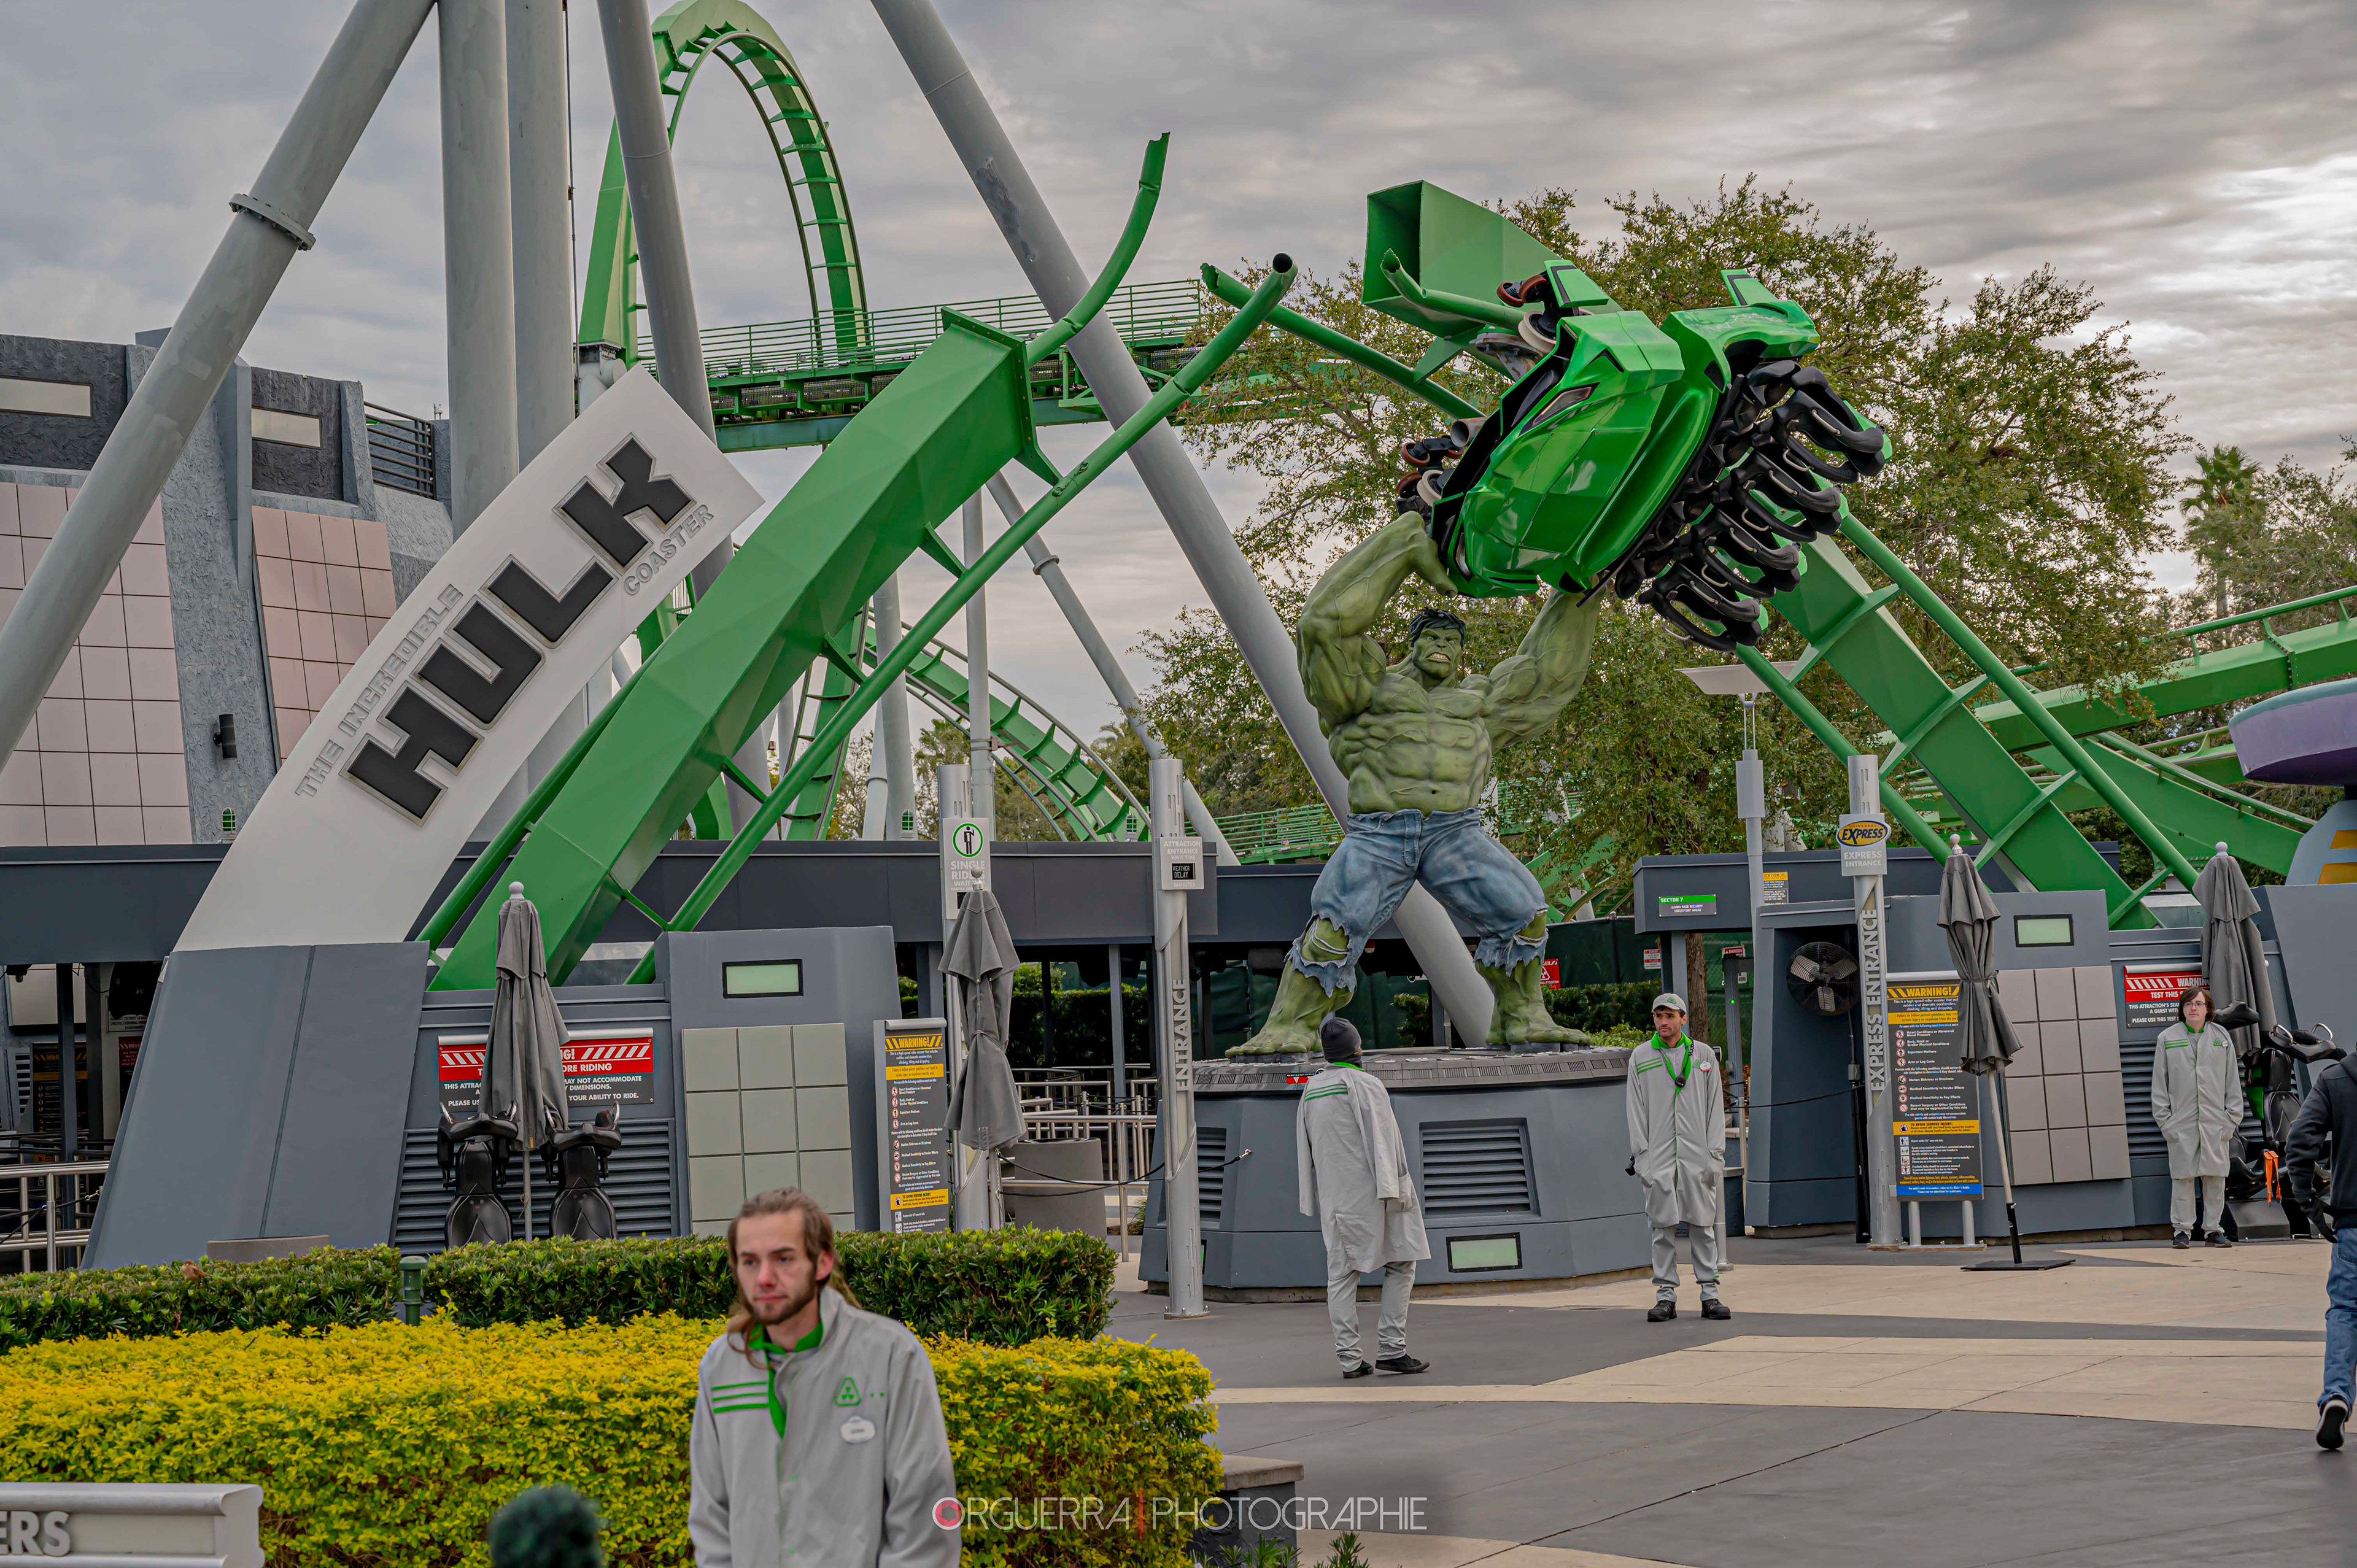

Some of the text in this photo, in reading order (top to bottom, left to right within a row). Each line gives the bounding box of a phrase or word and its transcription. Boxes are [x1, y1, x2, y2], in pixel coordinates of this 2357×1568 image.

[622, 504, 714, 595] COASTER
[339, 431, 696, 827] HULK
[295, 584, 463, 798] THE INCREDIBLE
[1842, 828, 1884, 844] EXPRESS
[1844, 851, 1882, 859] EXPRESS
[952, 870, 985, 879] RIDS
[1906, 987, 1952, 997] WARNING!
[1862, 910, 1885, 1091] EXPRESS ENTRANCE
[899, 1037, 929, 1048] WARNING!
[1172, 979, 1190, 1091] ENTRANCE
[580, 1063, 612, 1072] RIDING
